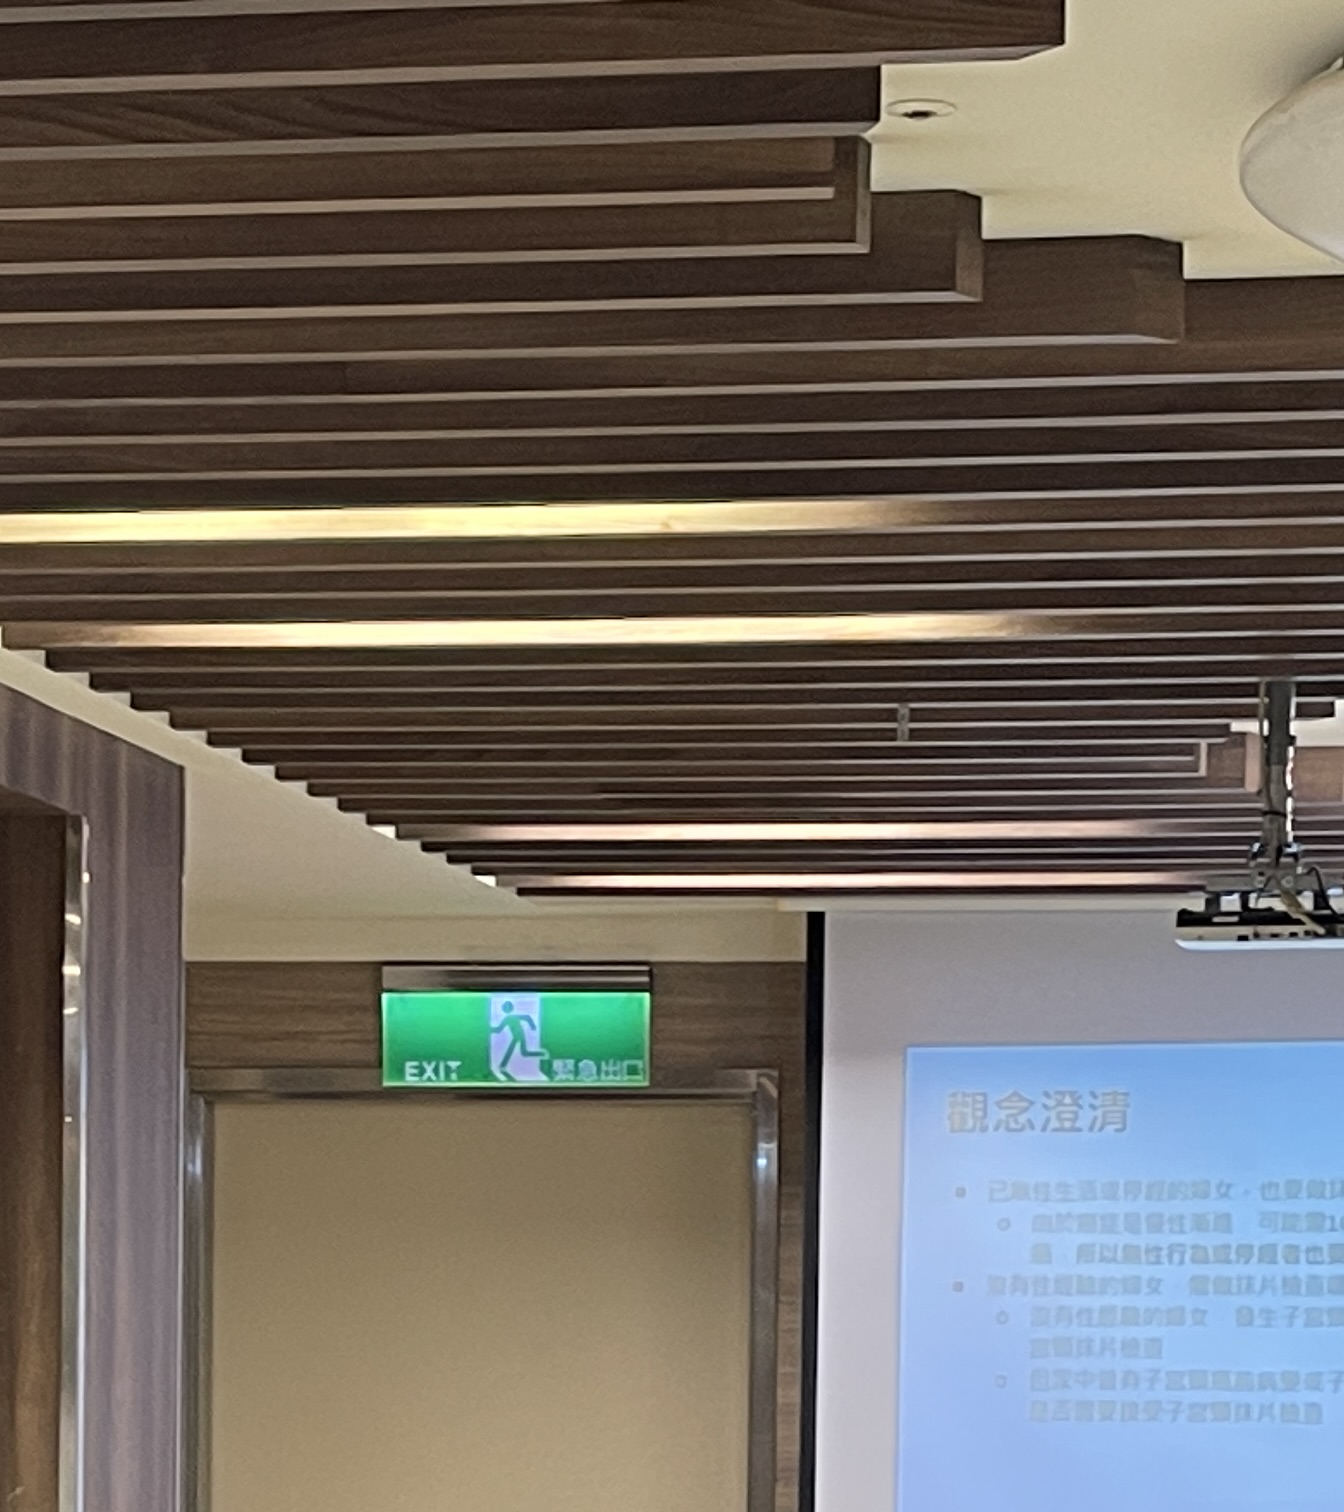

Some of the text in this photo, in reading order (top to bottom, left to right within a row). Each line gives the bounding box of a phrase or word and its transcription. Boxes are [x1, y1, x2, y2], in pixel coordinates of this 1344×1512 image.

[404, 1060, 462, 1082] EXIT
[552, 1059, 643, 1082] 緊急出口
[946, 1089, 1132, 1134] 觀念澄清
